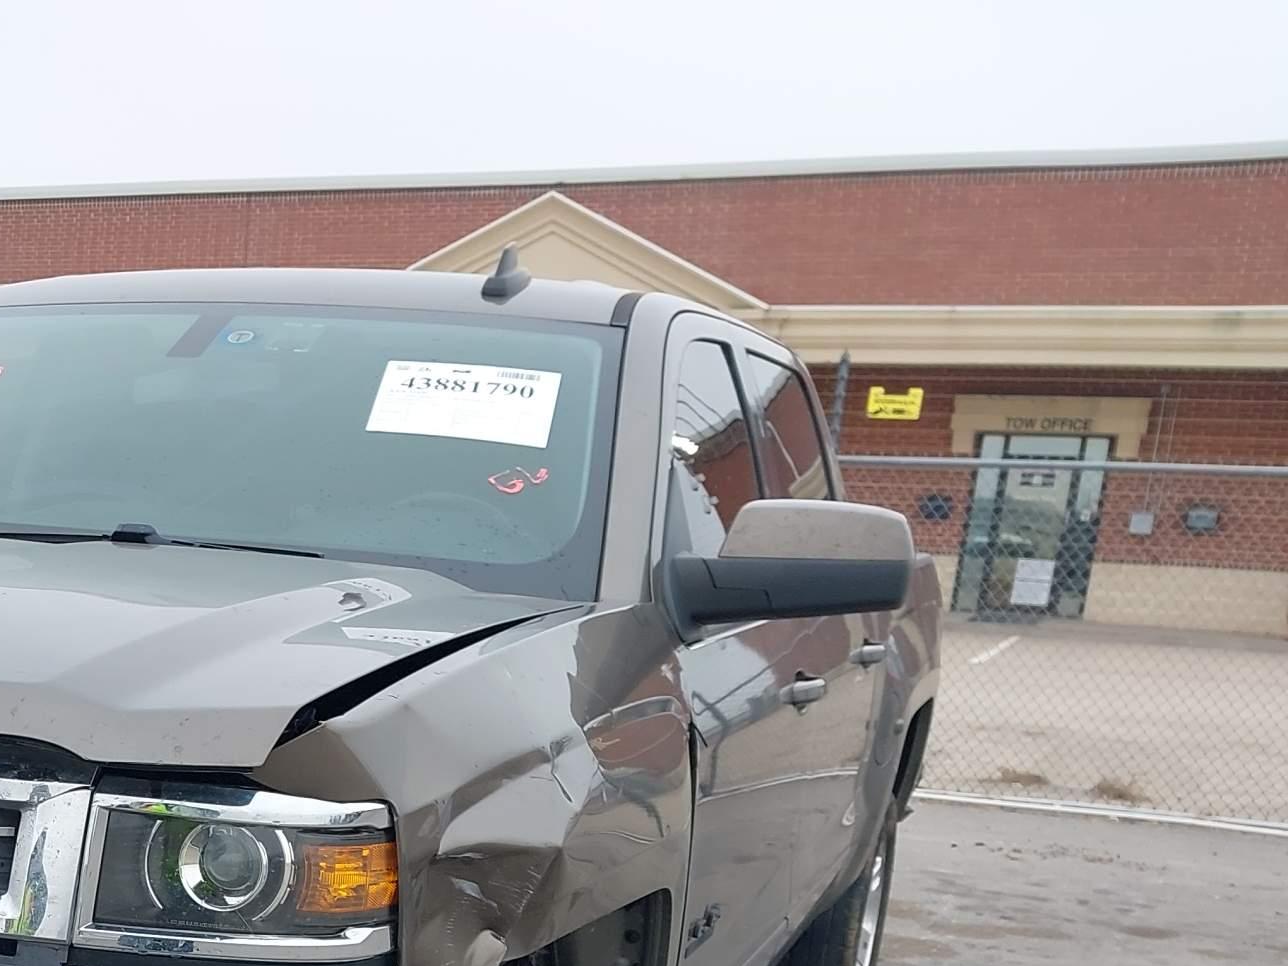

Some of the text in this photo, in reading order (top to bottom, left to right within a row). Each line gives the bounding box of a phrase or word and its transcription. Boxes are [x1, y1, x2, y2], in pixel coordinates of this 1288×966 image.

[400, 376, 535, 399] 43881790
[1005, 417, 1092, 432] TOW OFFICE
